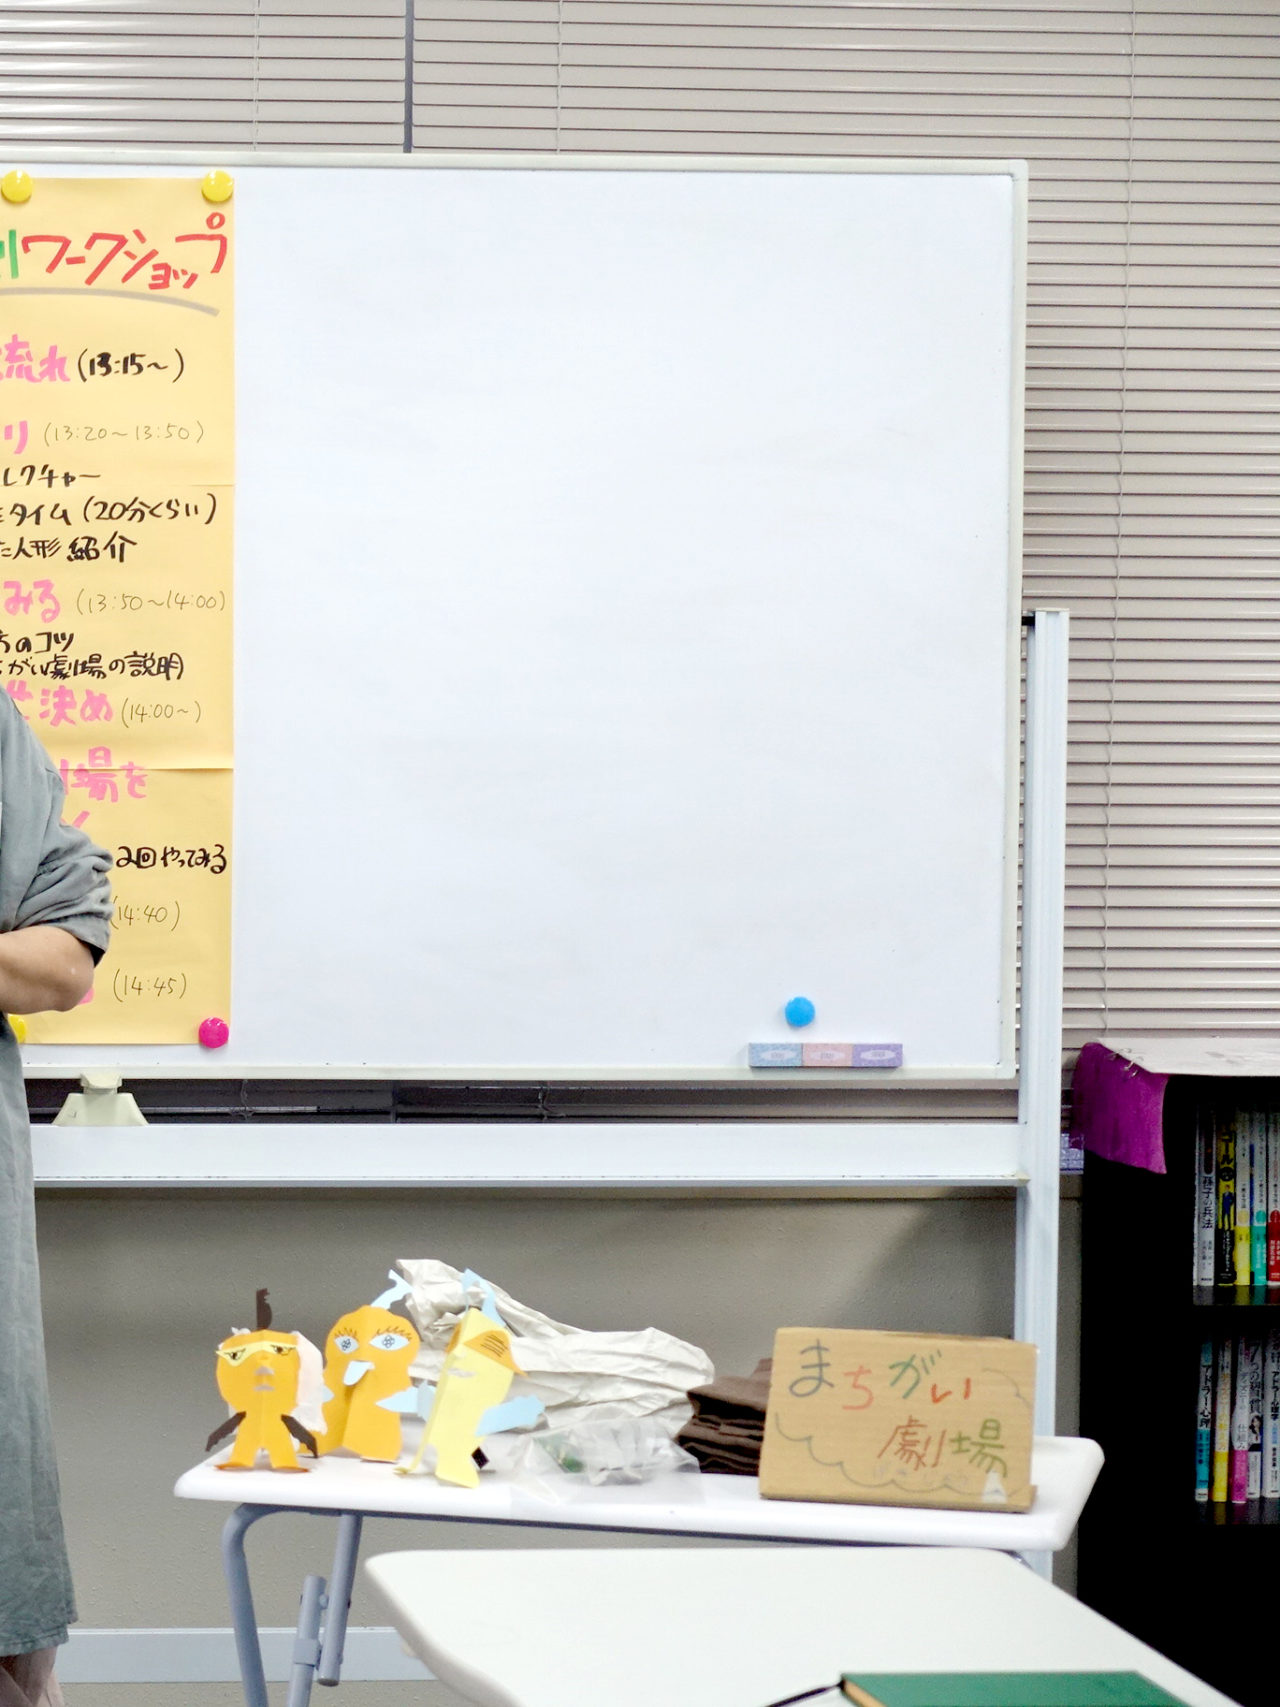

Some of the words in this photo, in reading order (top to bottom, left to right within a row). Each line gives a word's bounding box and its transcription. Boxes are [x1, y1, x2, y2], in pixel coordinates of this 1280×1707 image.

[59, 745, 149, 803] 場を
[108, 895, 181, 931] (14:40)
[112, 968, 188, 1004] (14:45)
[788, 1338, 972, 1411] まちがい
[877, 1415, 1008, 1479] 劇場
